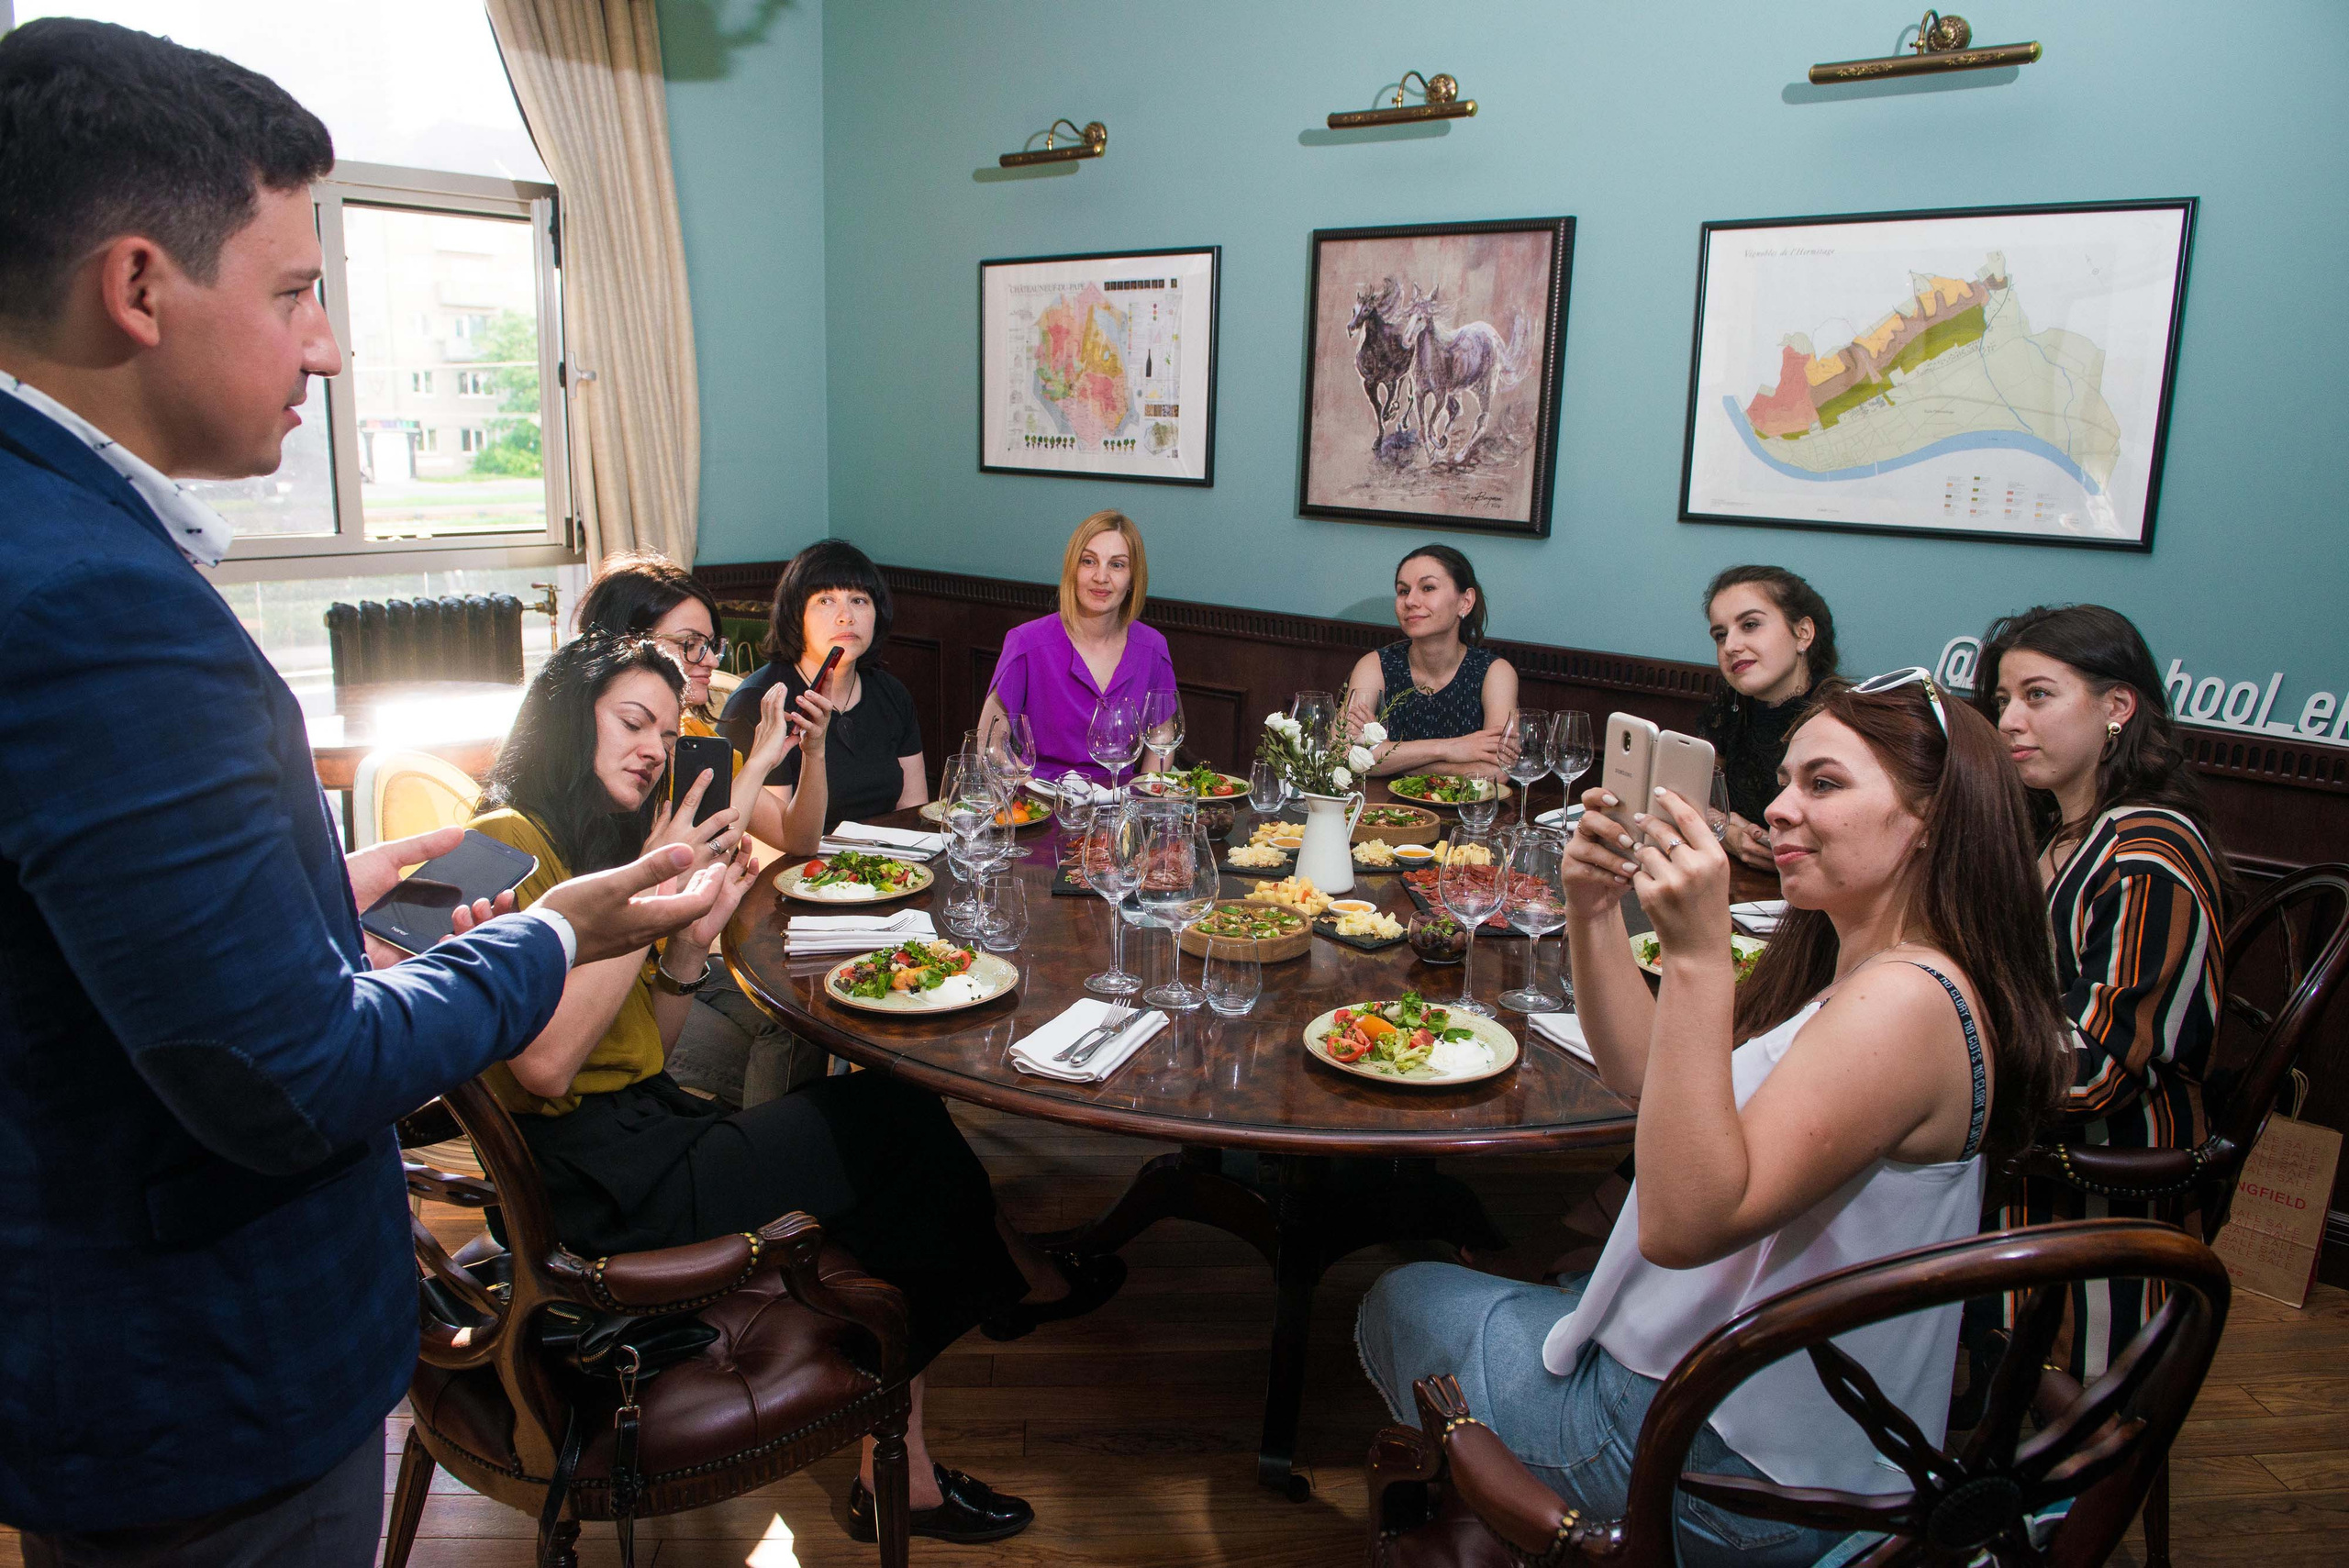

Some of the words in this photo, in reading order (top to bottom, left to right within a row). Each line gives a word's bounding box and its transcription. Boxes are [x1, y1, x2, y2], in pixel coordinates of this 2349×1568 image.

[1940, 977, 1953, 989] NO
[1951, 989, 1970, 1017] GLORY
[1964, 1020, 1975, 1035] NO
[1973, 1064, 1984, 1080] NO
[2277, 1173, 2311, 1190] SALE
[2238, 1181, 2306, 1210] NGFIELD
[2221, 1241, 2253, 1259] SALE
[2222, 1233, 2254, 1249] SALE
